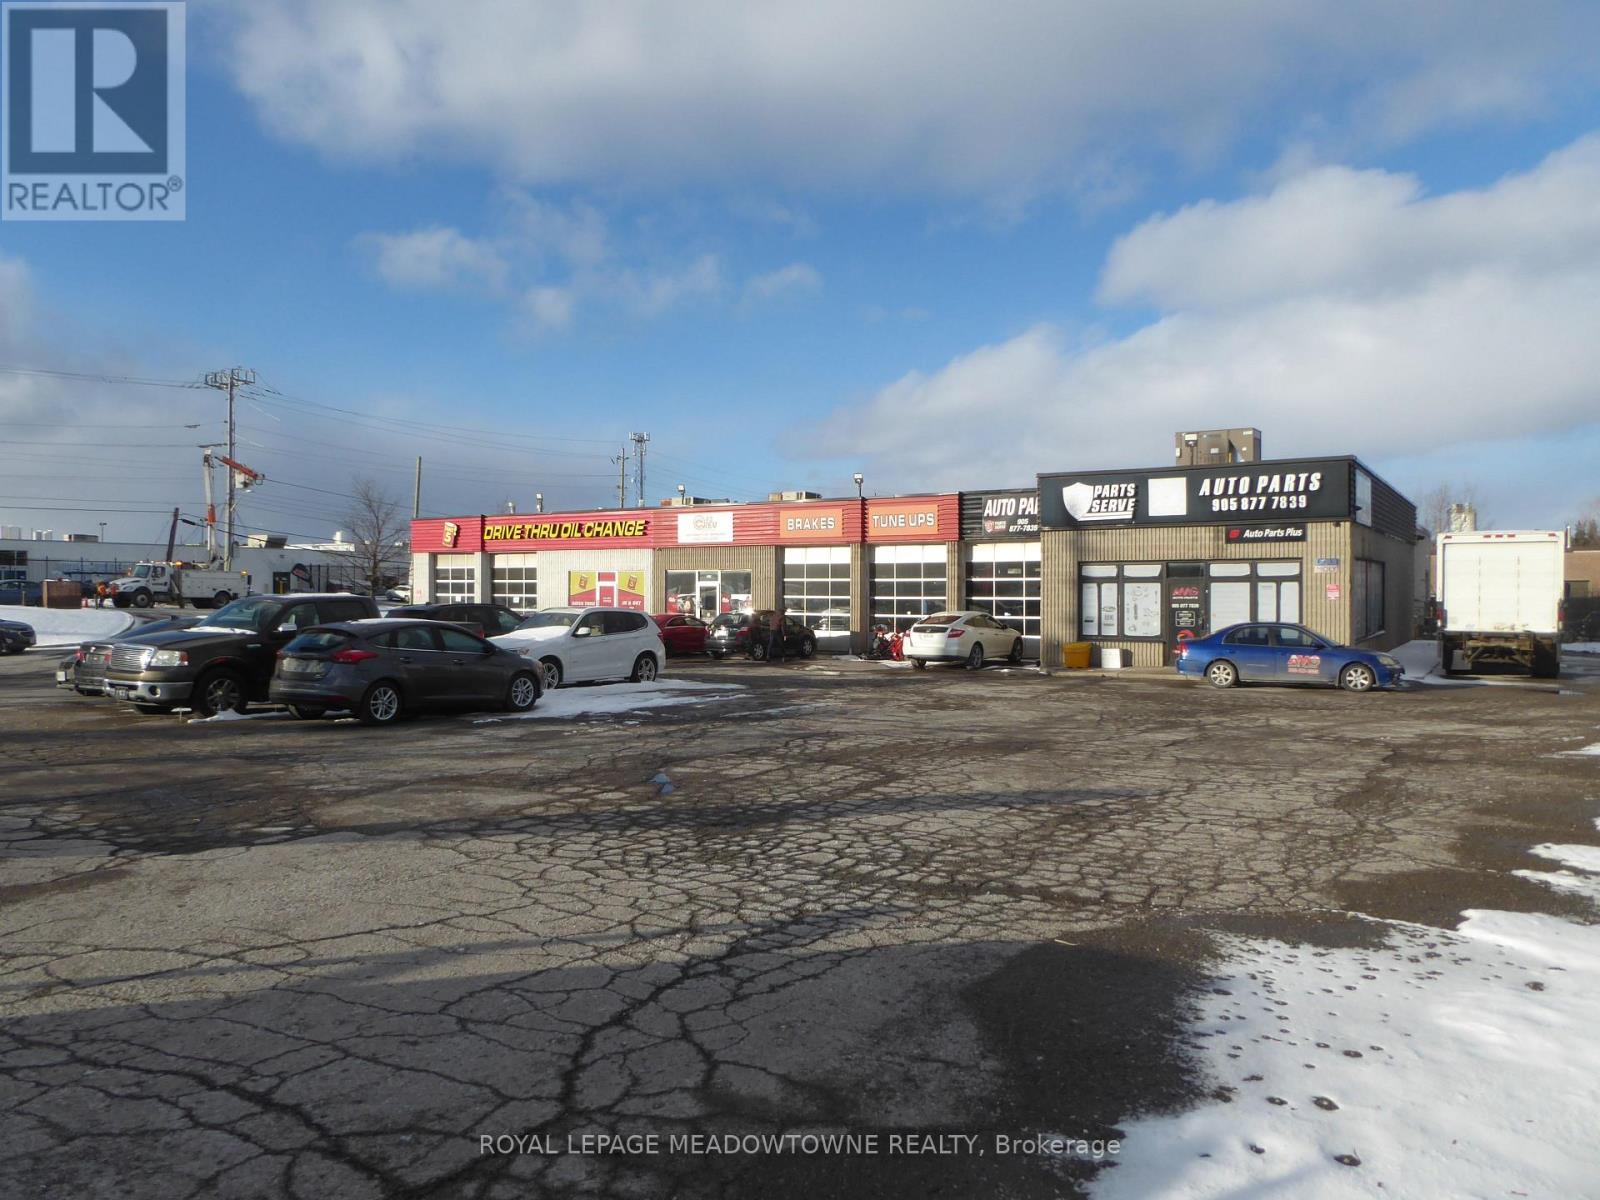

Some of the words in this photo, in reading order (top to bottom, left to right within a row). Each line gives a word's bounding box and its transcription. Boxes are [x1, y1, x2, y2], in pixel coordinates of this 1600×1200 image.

[1093, 483, 1136, 499] PARTS
[1199, 476, 1251, 496] AUTO
[1256, 472, 1322, 494] PARTS
[983, 498, 1016, 517] AUTO
[1091, 498, 1136, 512] SERVE
[1212, 498, 1238, 512] 905
[1241, 497, 1267, 511] 877
[1271, 495, 1308, 509] 7839
[787, 517, 836, 531] BRAKES
[872, 514, 906, 528] TUNE
[908, 512, 936, 527] UPS
[483, 525, 521, 540] DRIVE
[523, 524, 559, 539] THRU
[560, 522, 582, 538] OIL
[583, 520, 646, 537] CHANGE
[1243, 530, 1263, 538] Auto
[1264, 529, 1285, 537] Parts
[1285, 527, 1303, 537] Plus
